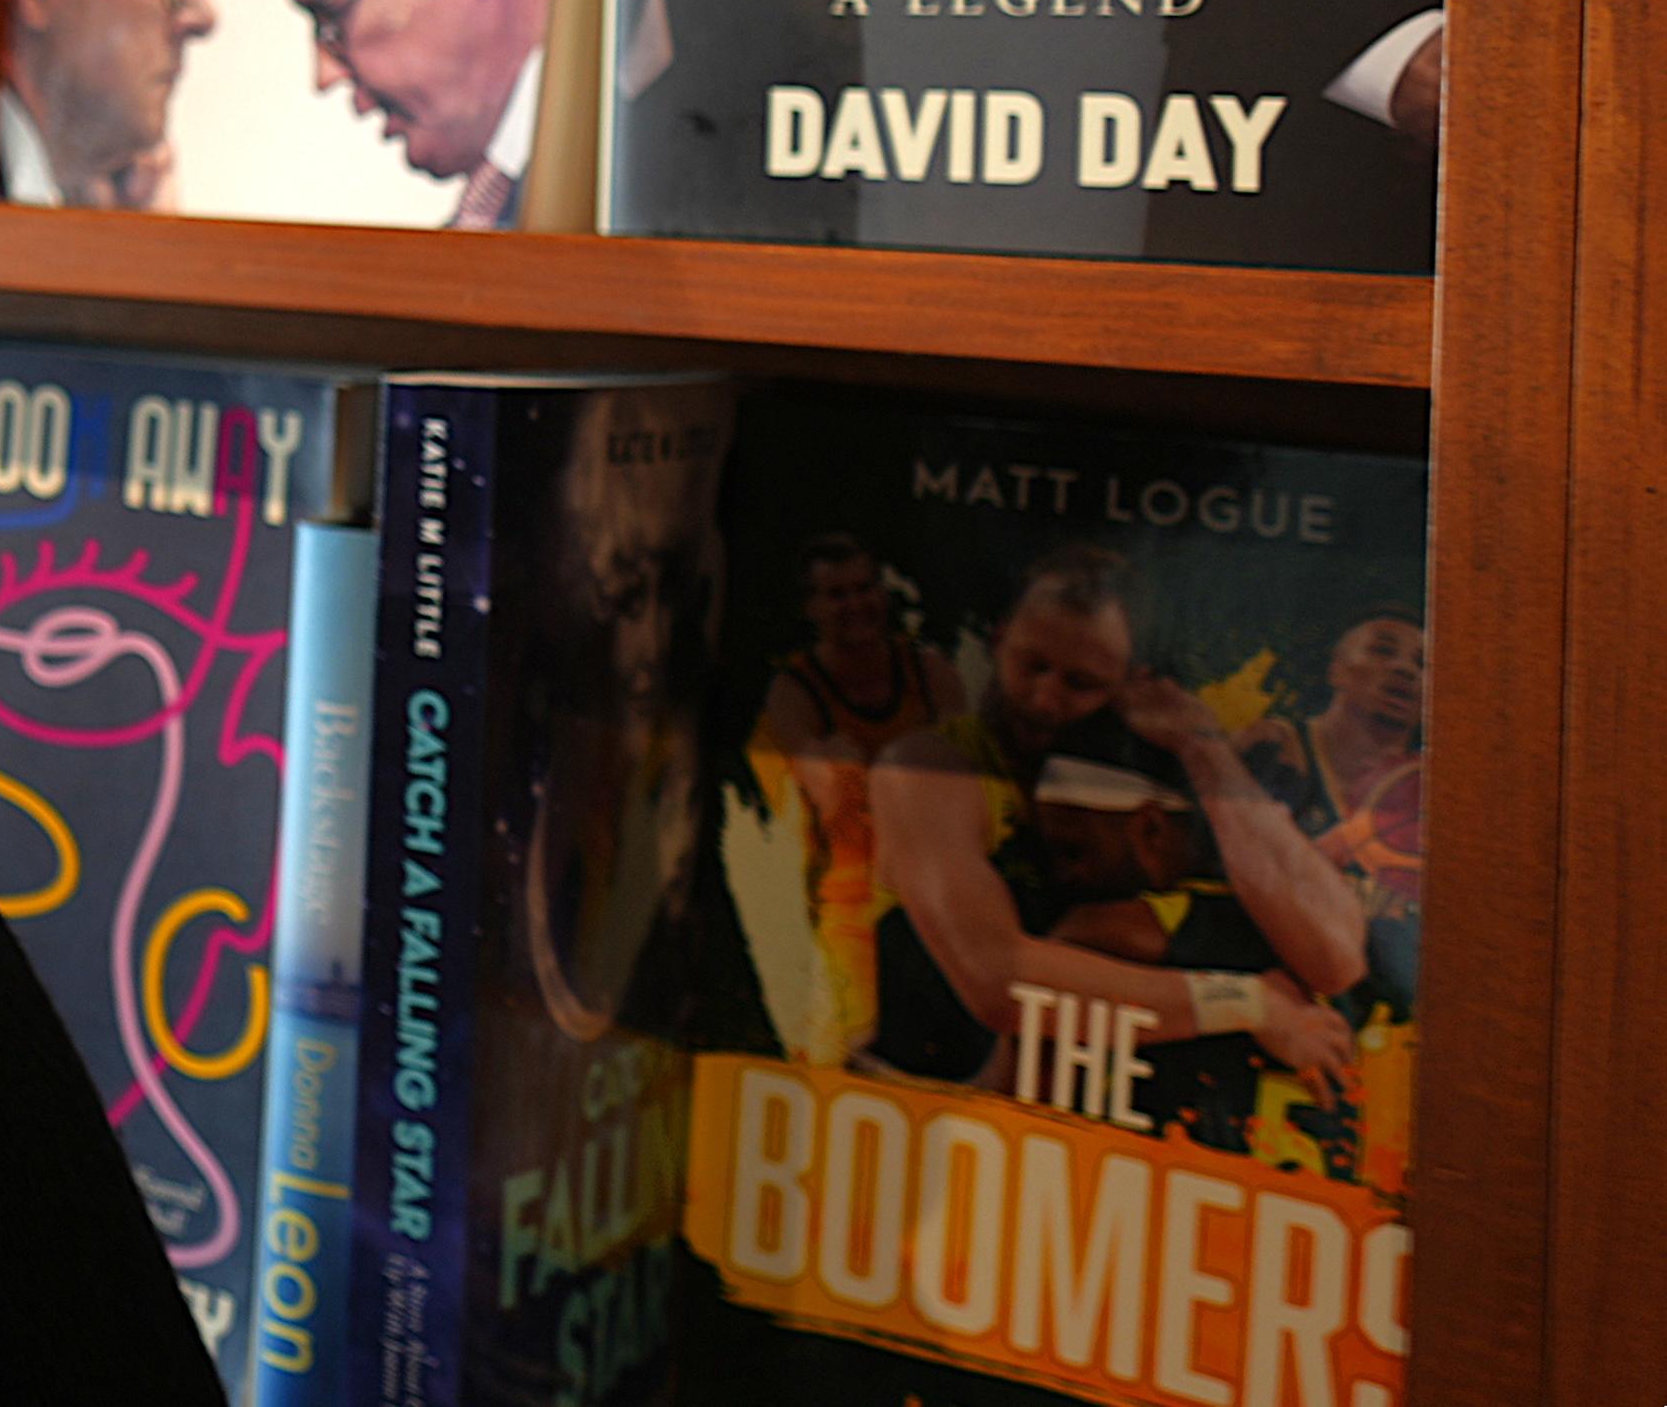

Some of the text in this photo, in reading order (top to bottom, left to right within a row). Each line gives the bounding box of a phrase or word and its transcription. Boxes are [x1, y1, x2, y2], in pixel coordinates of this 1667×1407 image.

[765, 84, 1289, 194] DAVID DAY
[411, 416, 452, 662] KATIE M LITTLE
[912, 457, 1338, 546] MATT LOGUE
[389, 686, 453, 1244] CATCH A FALLING STAR
[1008, 980, 1160, 1132] THE
[262, 1036, 352, 1376] Donna Leon
